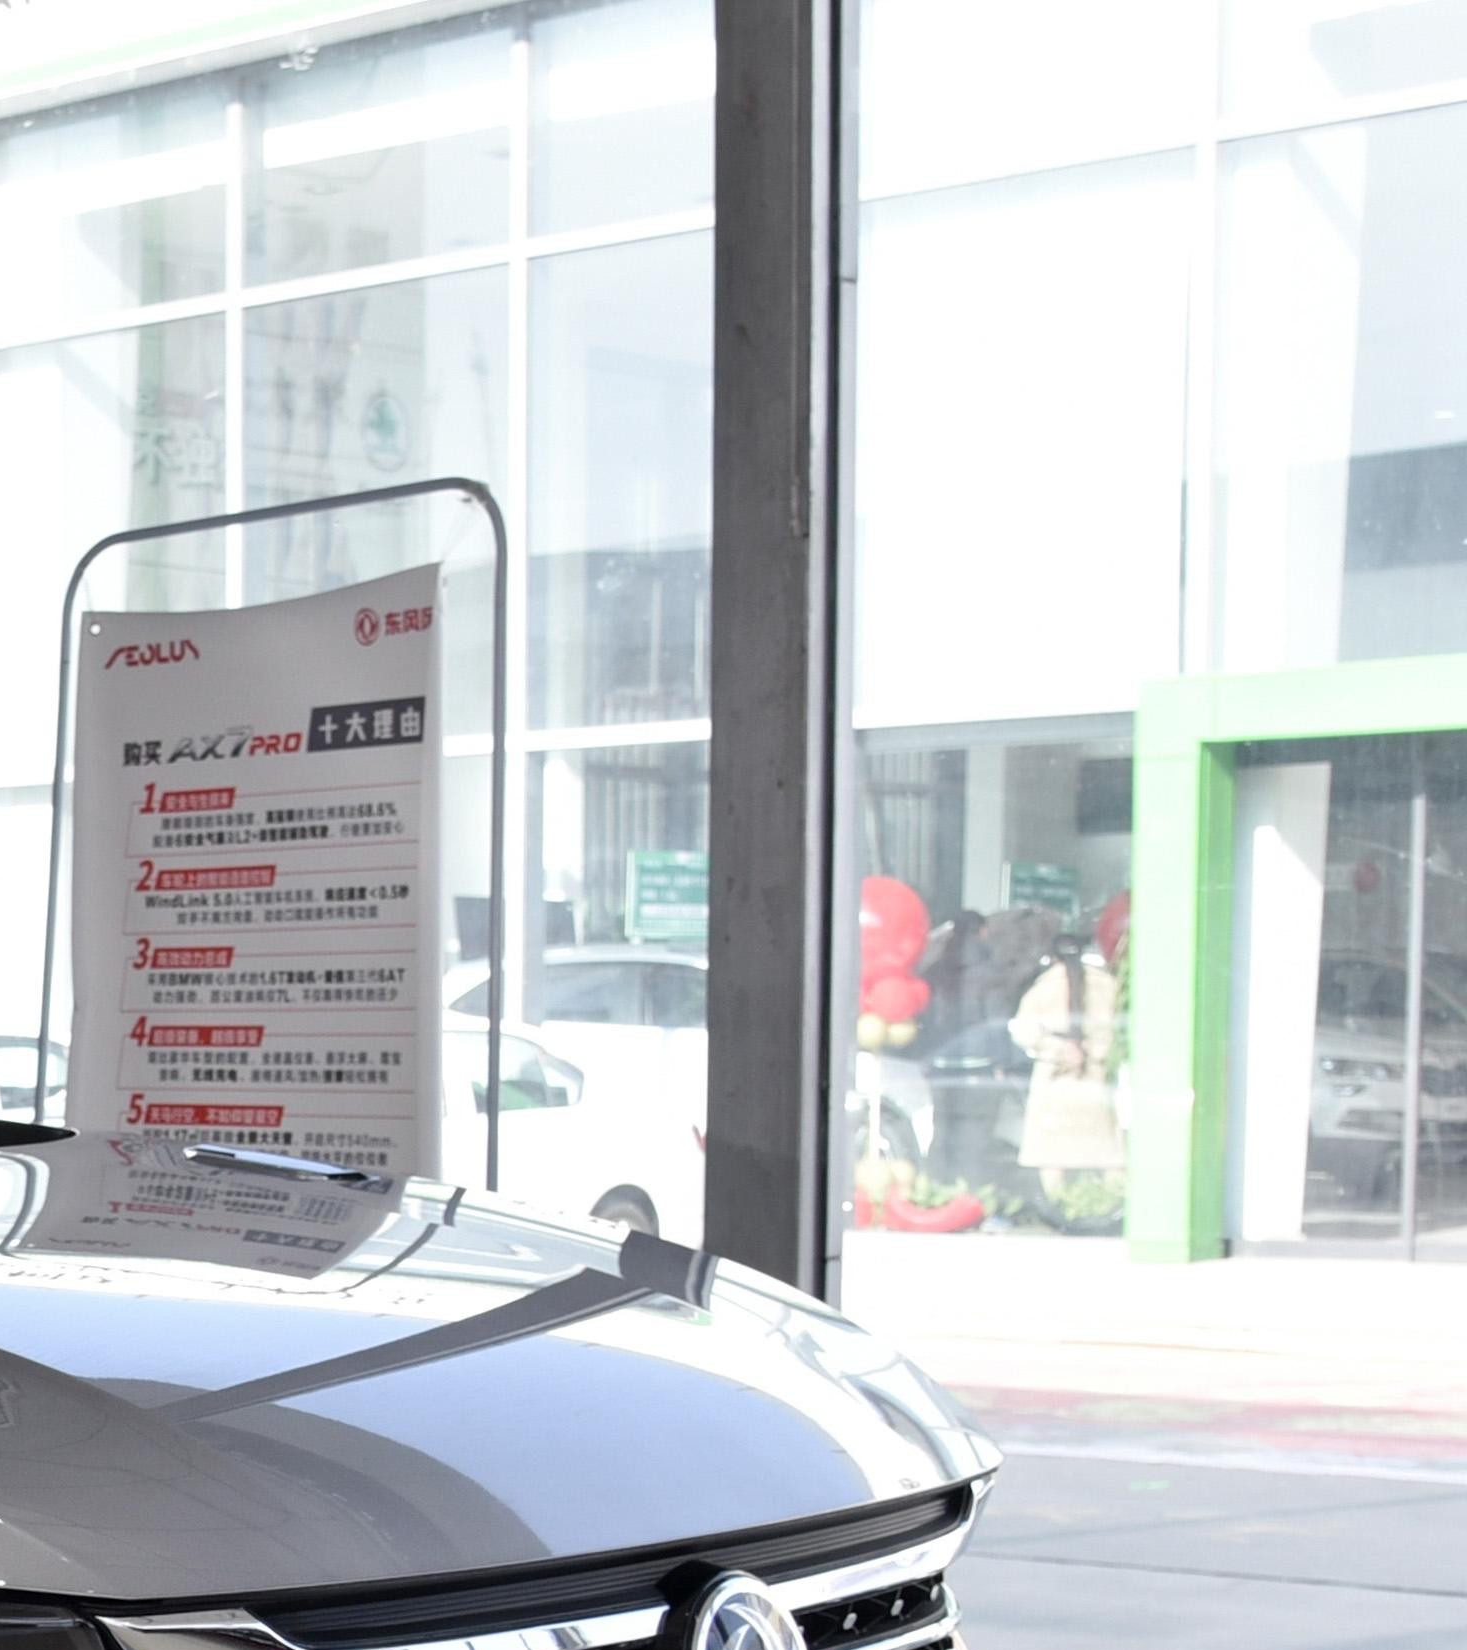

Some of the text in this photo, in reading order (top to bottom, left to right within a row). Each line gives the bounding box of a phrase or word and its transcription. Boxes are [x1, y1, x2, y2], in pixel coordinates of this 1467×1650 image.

[123, 740, 163, 767] 购买
[317, 707, 423, 744] 十大理由
[139, 782, 156, 814] 1
[135, 860, 154, 891] 2
[133, 937, 151, 970] 3
[130, 1015, 148, 1047] 4
[125, 1093, 145, 1125] 5
